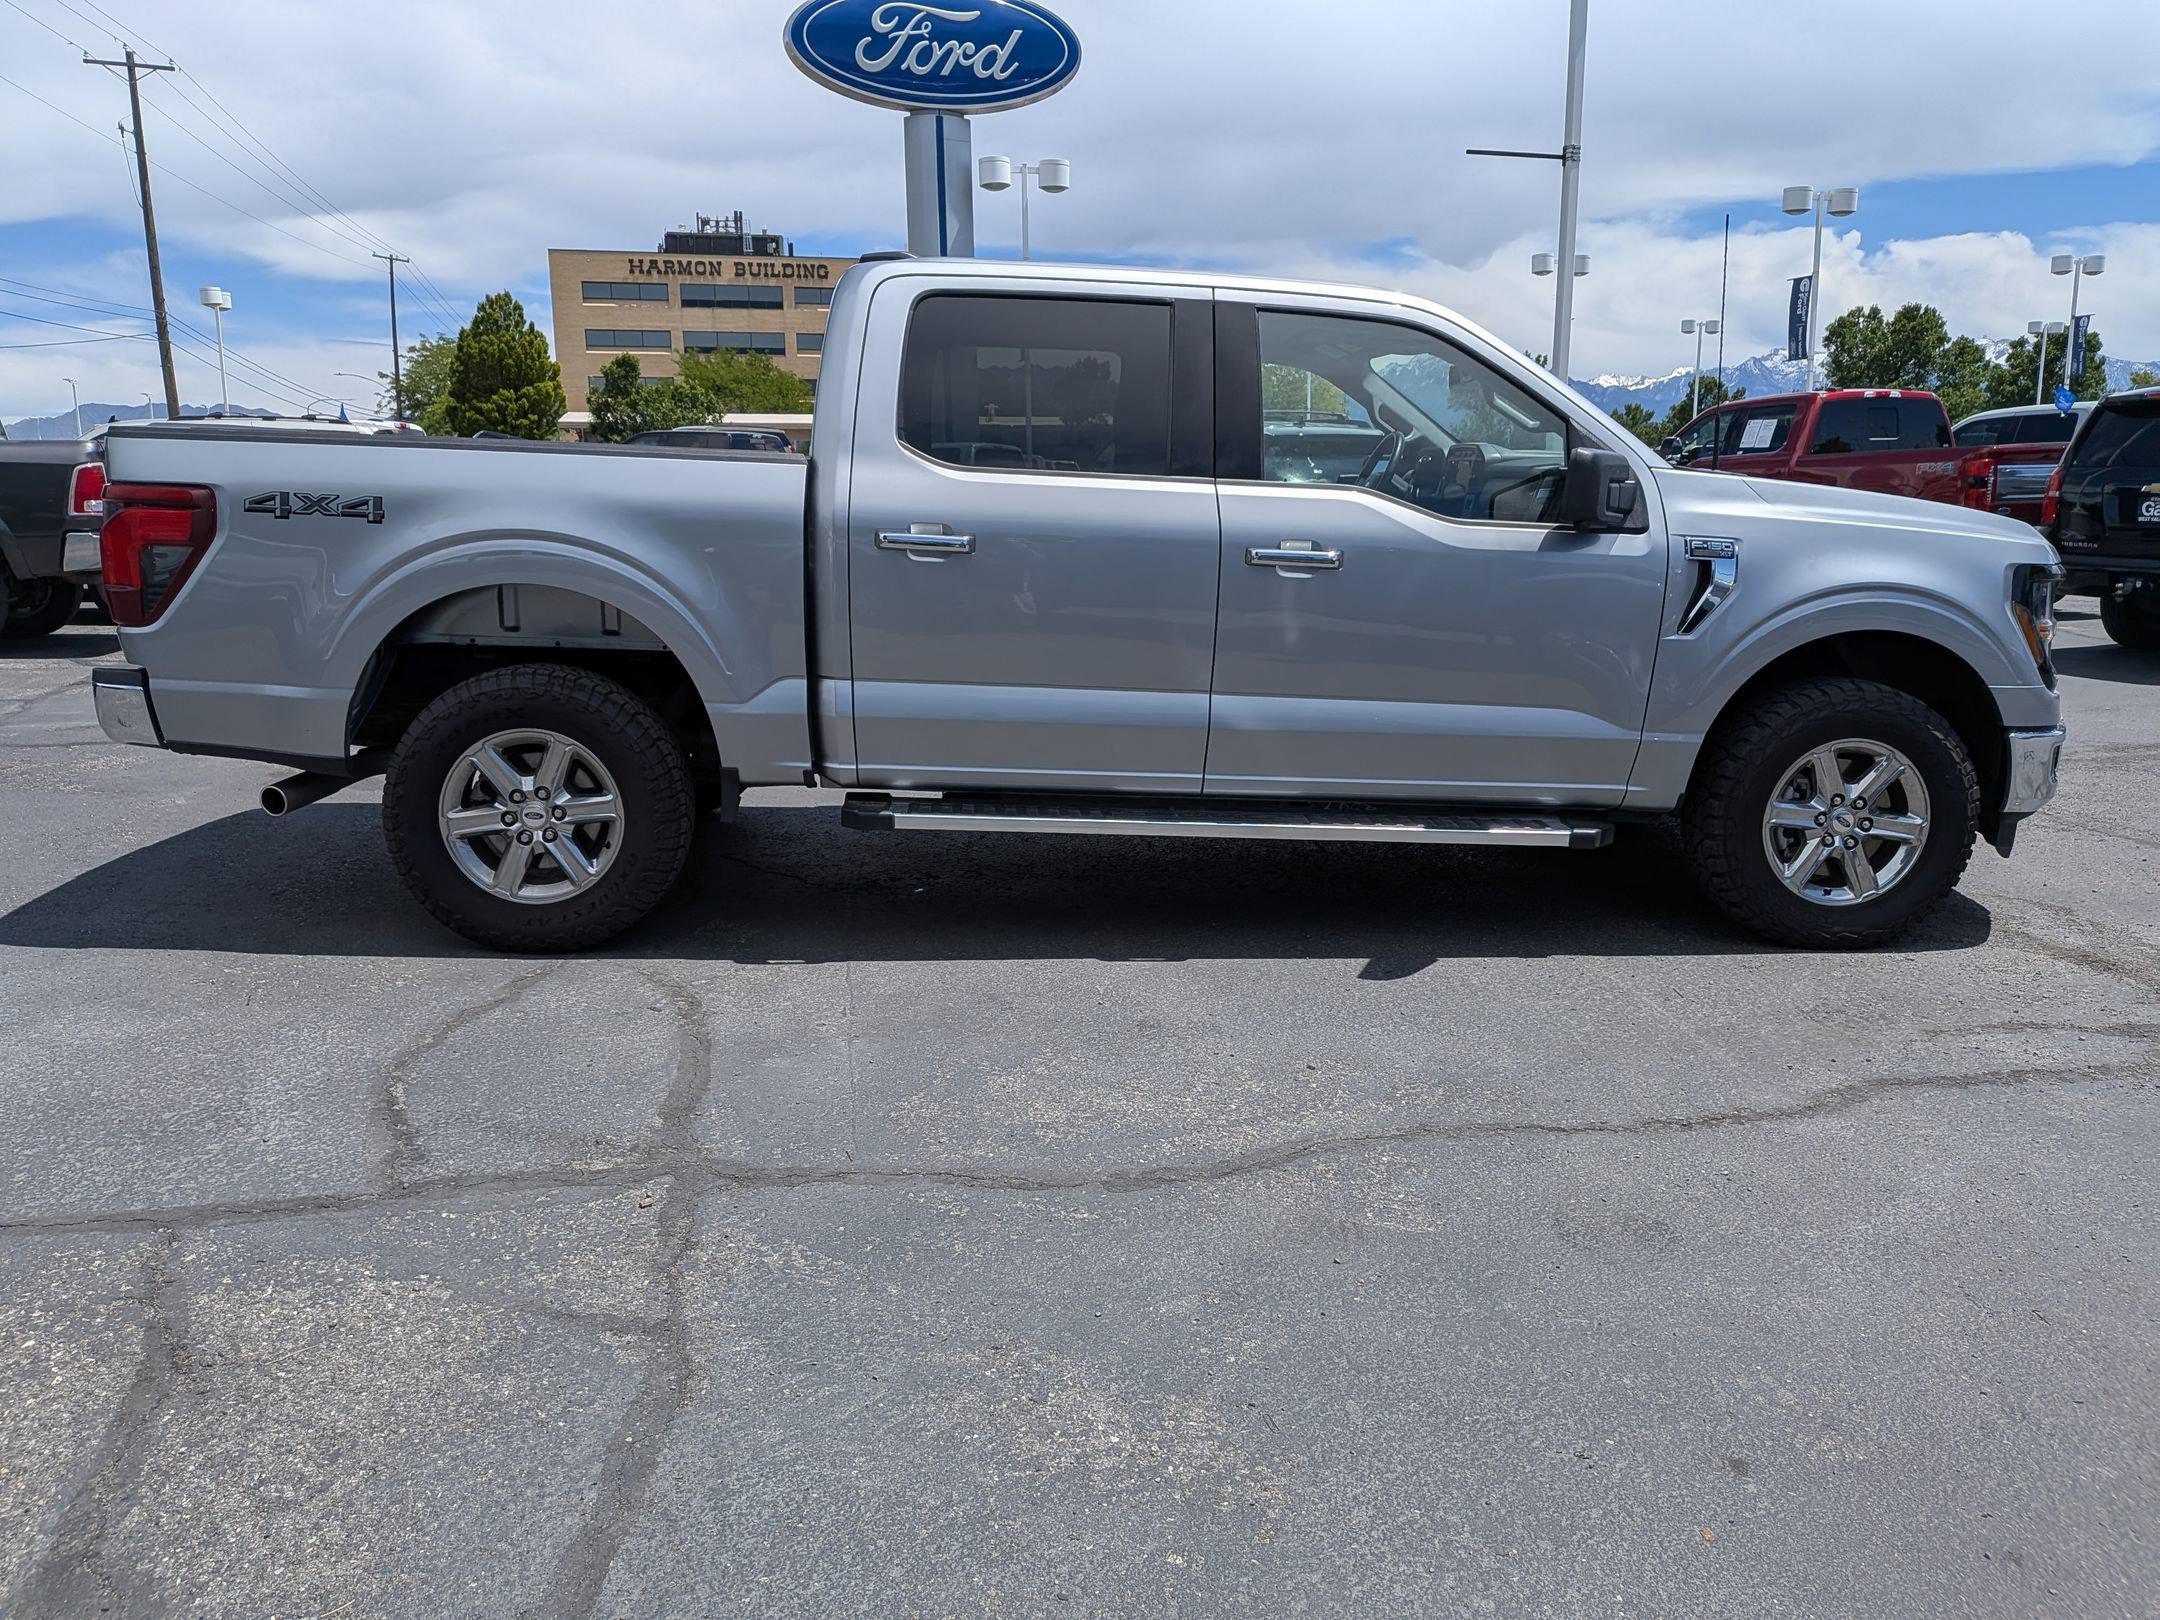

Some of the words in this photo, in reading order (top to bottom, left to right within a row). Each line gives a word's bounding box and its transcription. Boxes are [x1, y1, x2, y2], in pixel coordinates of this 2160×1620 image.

[855, 2, 1023, 80] Ford
[628, 258, 722, 277] HARMON
[733, 261, 829, 280] BUILDING
[1796, 293, 1804, 315] Ford
[244, 491, 385, 524] 4X4
[1692, 541, 1733, 551] F-150
